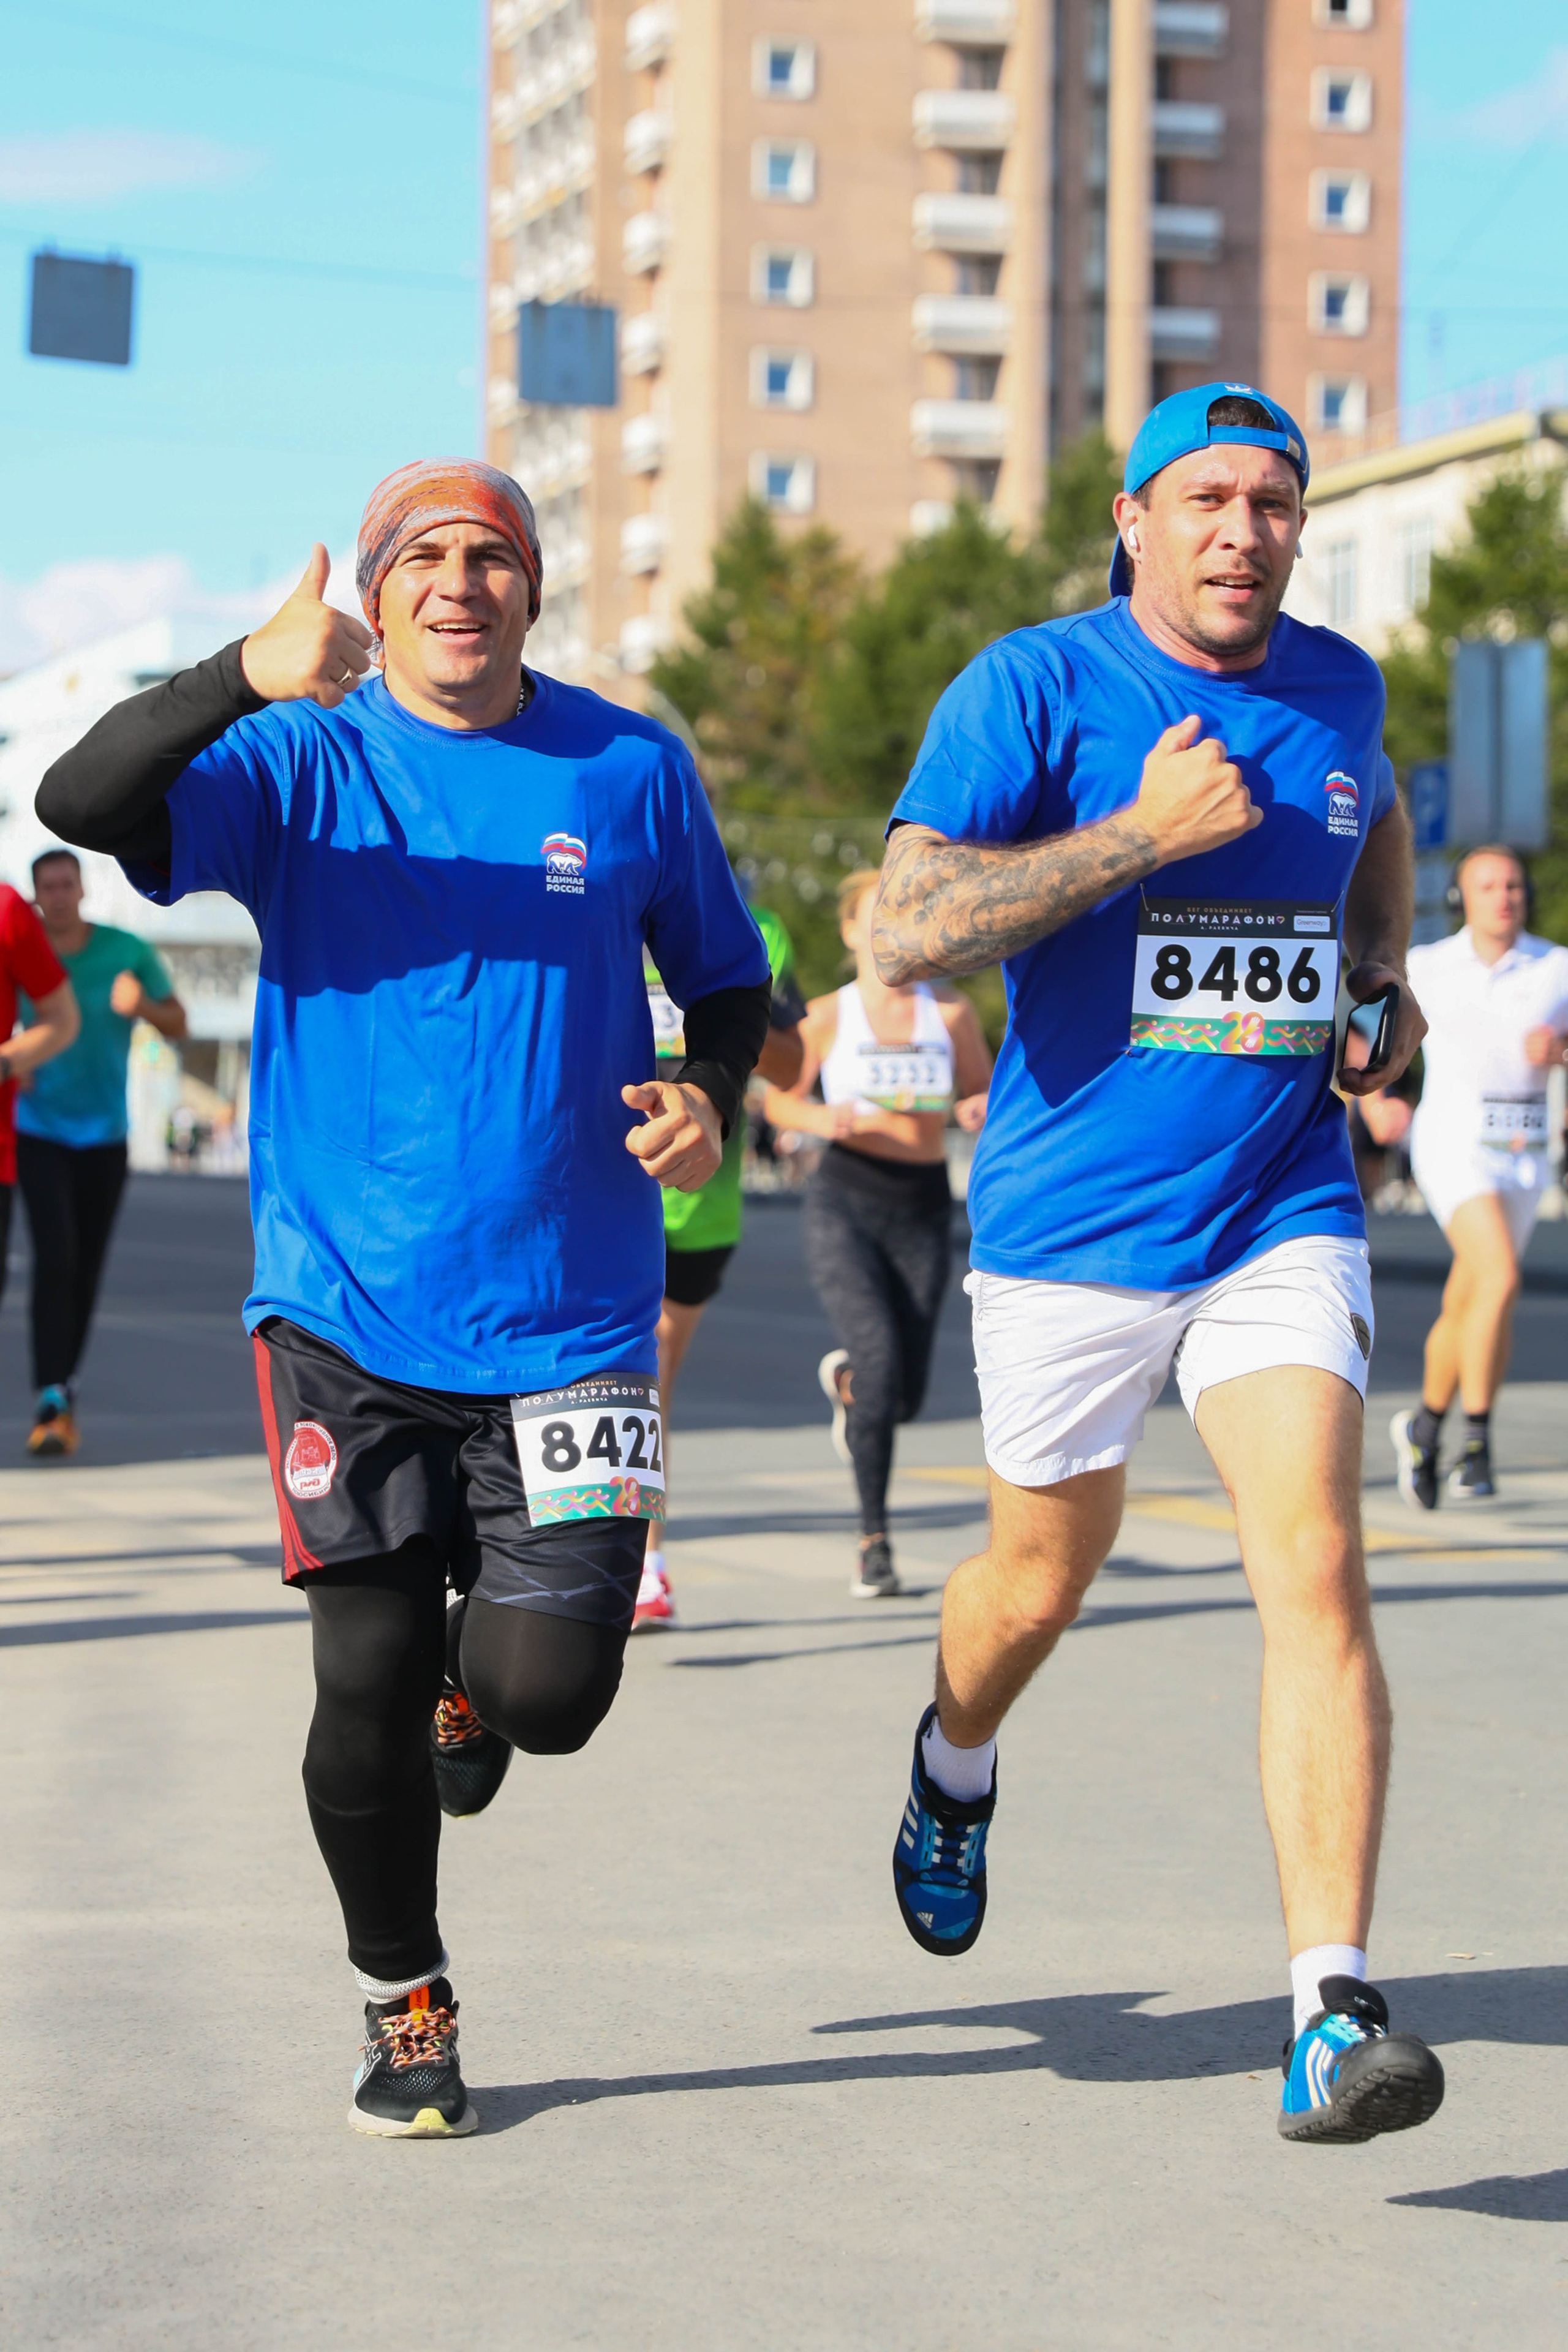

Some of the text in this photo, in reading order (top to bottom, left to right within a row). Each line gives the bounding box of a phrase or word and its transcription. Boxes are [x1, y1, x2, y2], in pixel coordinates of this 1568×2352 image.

[1327, 815, 1359, 827] ЕДИНАЯ
[1327, 826, 1359, 837] РОССИЯ
[546, 875, 585, 886] ЕДИНАЯ
[546, 884, 585, 895] РОССИЯ
[1151, 913, 1275, 925] ПОЛУМАРАФОН
[1150, 943, 1321, 1004] 8486
[521, 1387, 637, 1408] ПОЛУМАРАФОН
[541, 1415, 662, 1473] 8422
